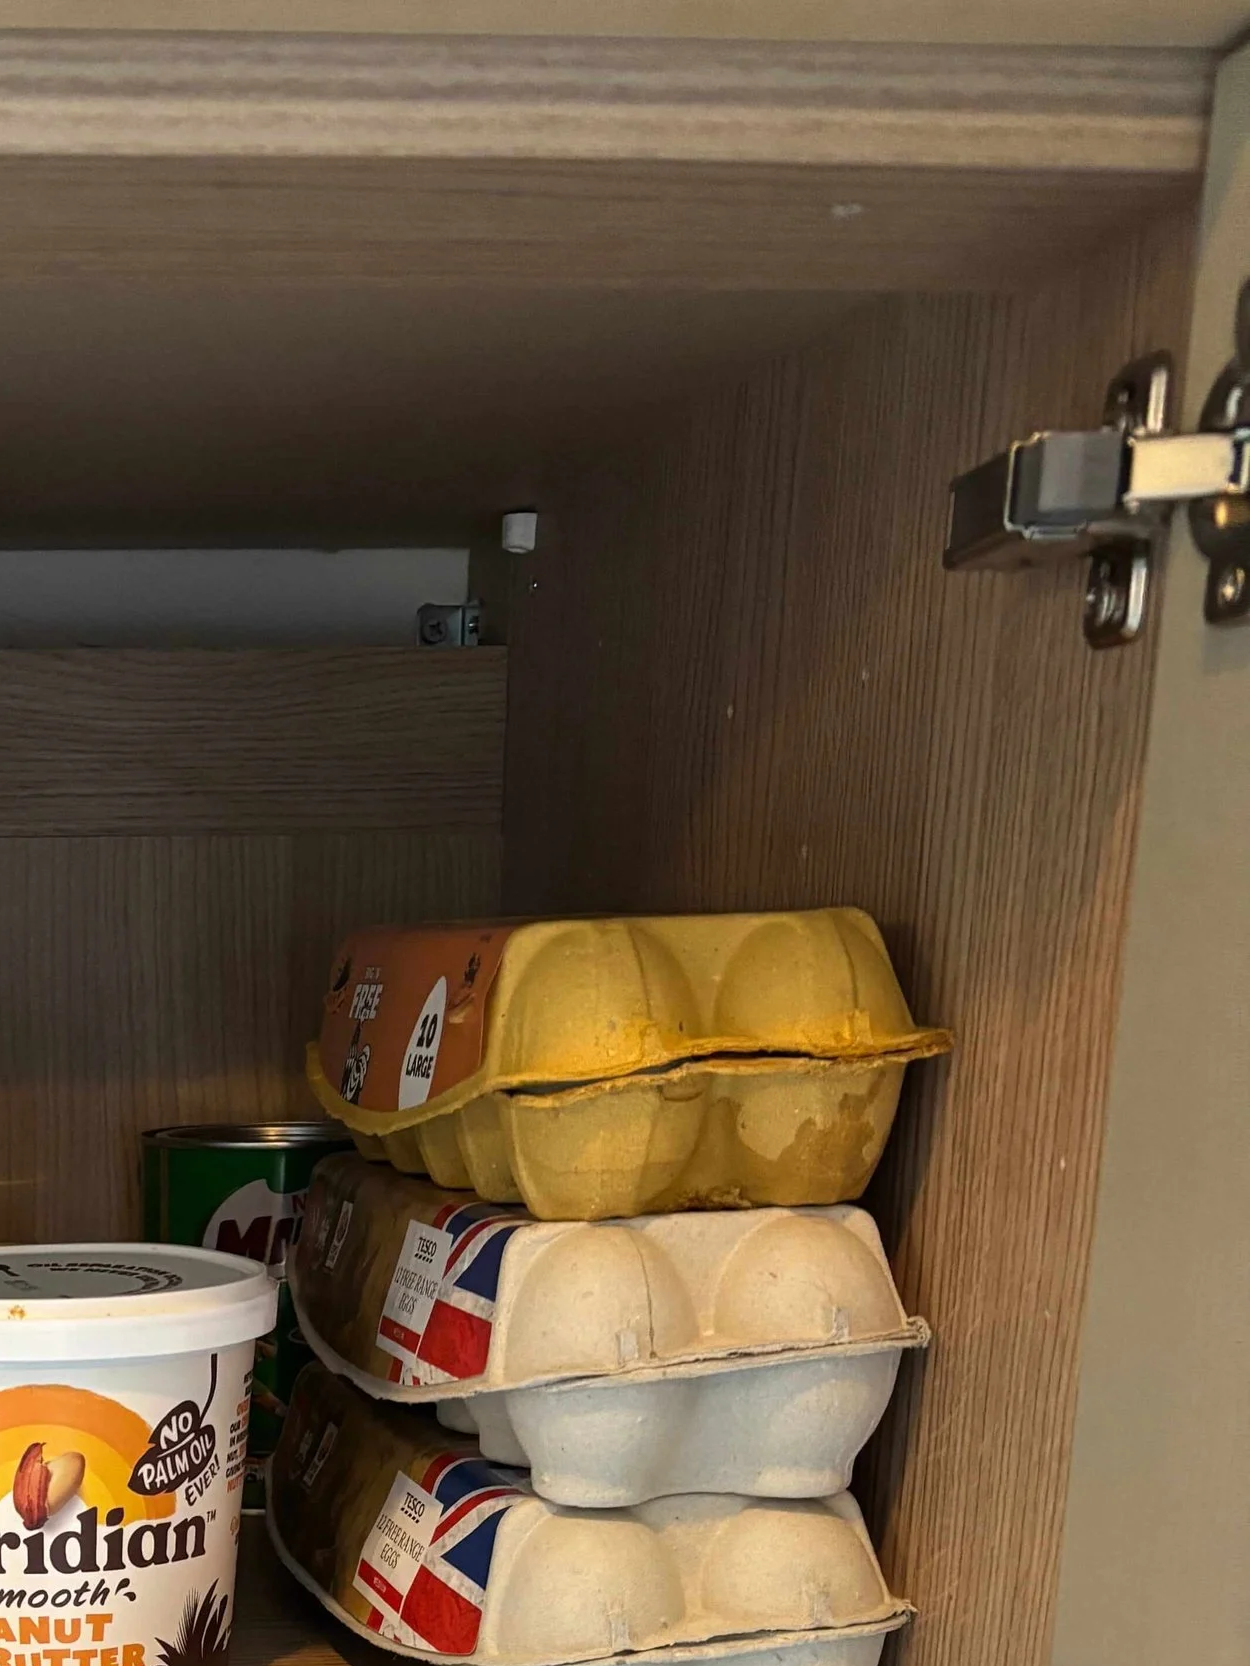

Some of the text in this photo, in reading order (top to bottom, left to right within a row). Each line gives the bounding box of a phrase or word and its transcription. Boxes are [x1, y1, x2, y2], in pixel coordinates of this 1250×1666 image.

[416, 1013, 438, 1049] 10
[405, 1053, 434, 1078] LARGE
[417, 1236, 437, 1258] TESCO
[402, 1269, 417, 1292] FREE
[415, 1273, 439, 1300] RANGE
[398, 1293, 417, 1315] EGGS
[159, 1411, 193, 1450] NO
[138, 1430, 213, 1491] PALM OIL
[184, 1454, 221, 1507] EVER!
[405, 1492, 425, 1517] TESCO
[376, 1514, 424, 1562] 12 FREE RANGE
[380, 1542, 401, 1570] EGGS
